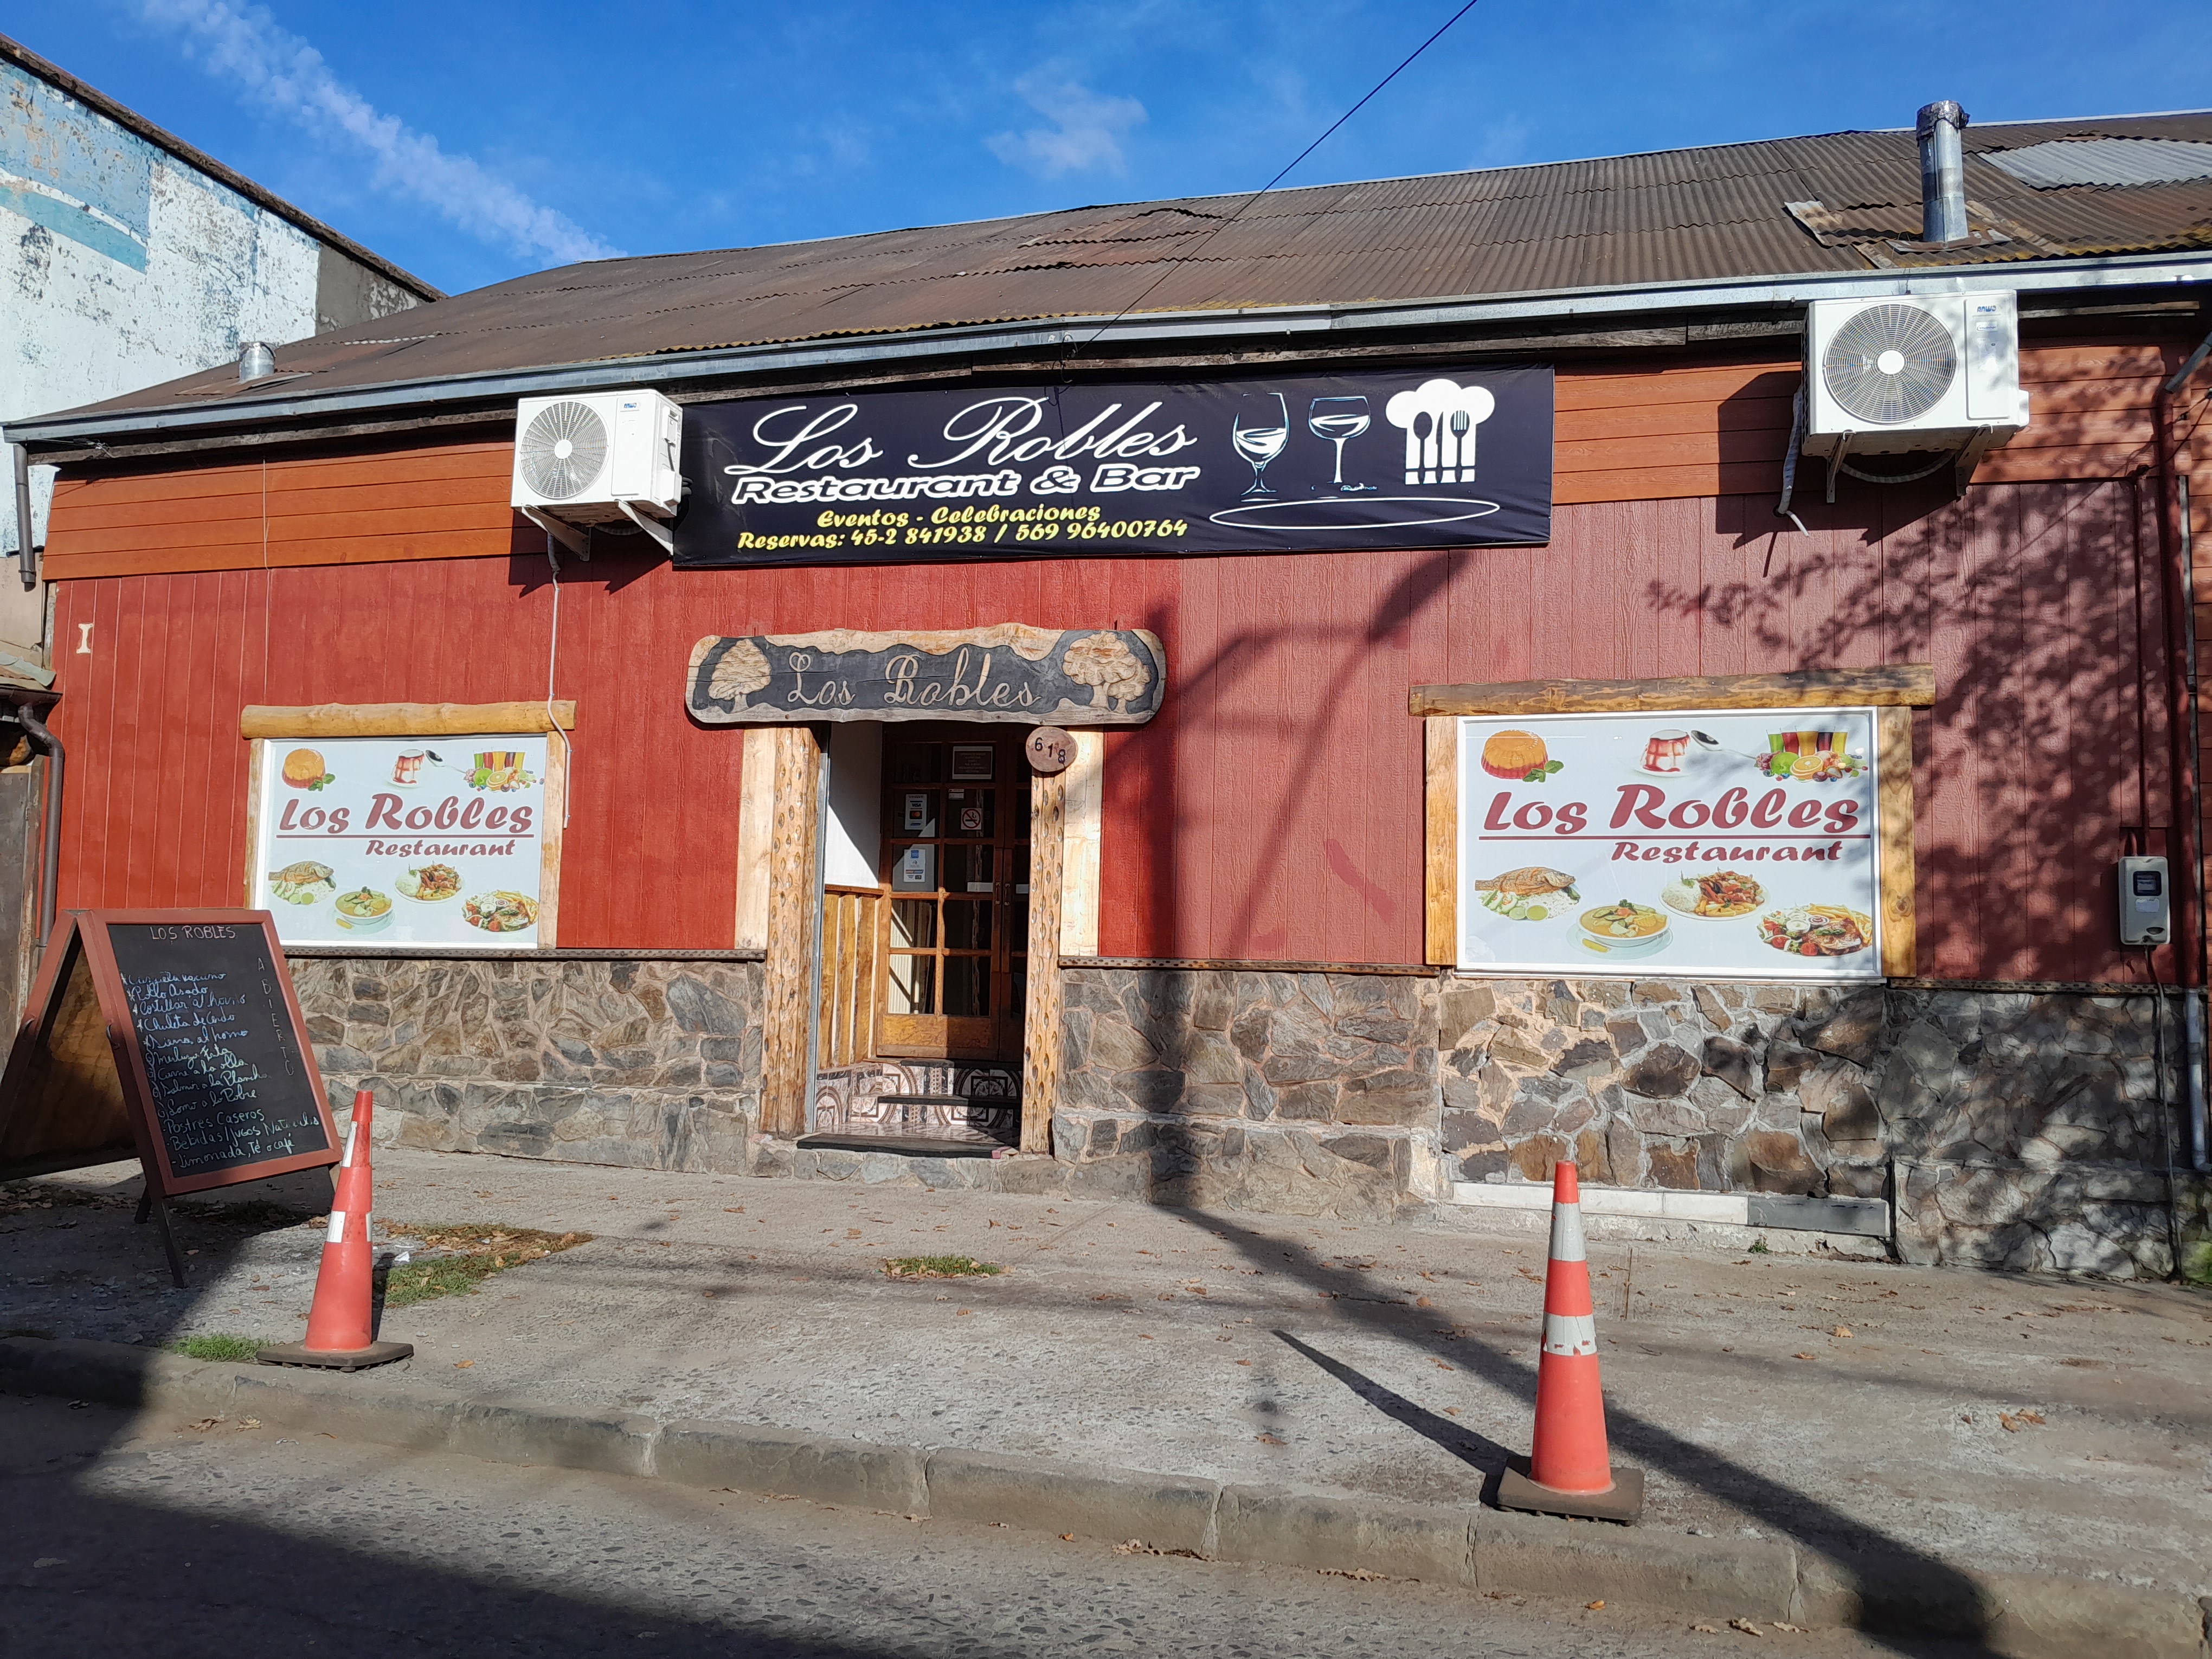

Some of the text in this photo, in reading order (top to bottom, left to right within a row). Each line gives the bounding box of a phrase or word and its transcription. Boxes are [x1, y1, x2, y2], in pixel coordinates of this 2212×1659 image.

[724, 396, 1198, 475] Los Robles
[731, 463, 1201, 505] Restaurant & Bar
[817, 509, 909, 528] Eventos
[931, 503, 1101, 524] Celebraciones
[737, 532, 845, 550] Reservas:
[851, 529, 898, 546] 45-2
[905, 524, 986, 544] 841938
[1015, 524, 1059, 541] 569
[1066, 519, 1188, 540] 96400764
[787, 647, 1043, 708] Los Robles
[1035, 737, 1066, 764] 618
[279, 793, 534, 834] Los Robles
[1483, 784, 1860, 835] Los Robles
[365, 840, 517, 858] Restaurant
[1611, 841, 1843, 864] Restaurant
[150, 925, 236, 940] LOS ROBLES
[169, 982, 208, 997] Asado
[207, 992, 246, 1007] horo
[144, 1013, 191, 1031] Chuleta
[211, 1027, 249, 1042] horno
[157, 1068, 189, 1081] Carne
[217, 1109, 264, 1125] Caseros
